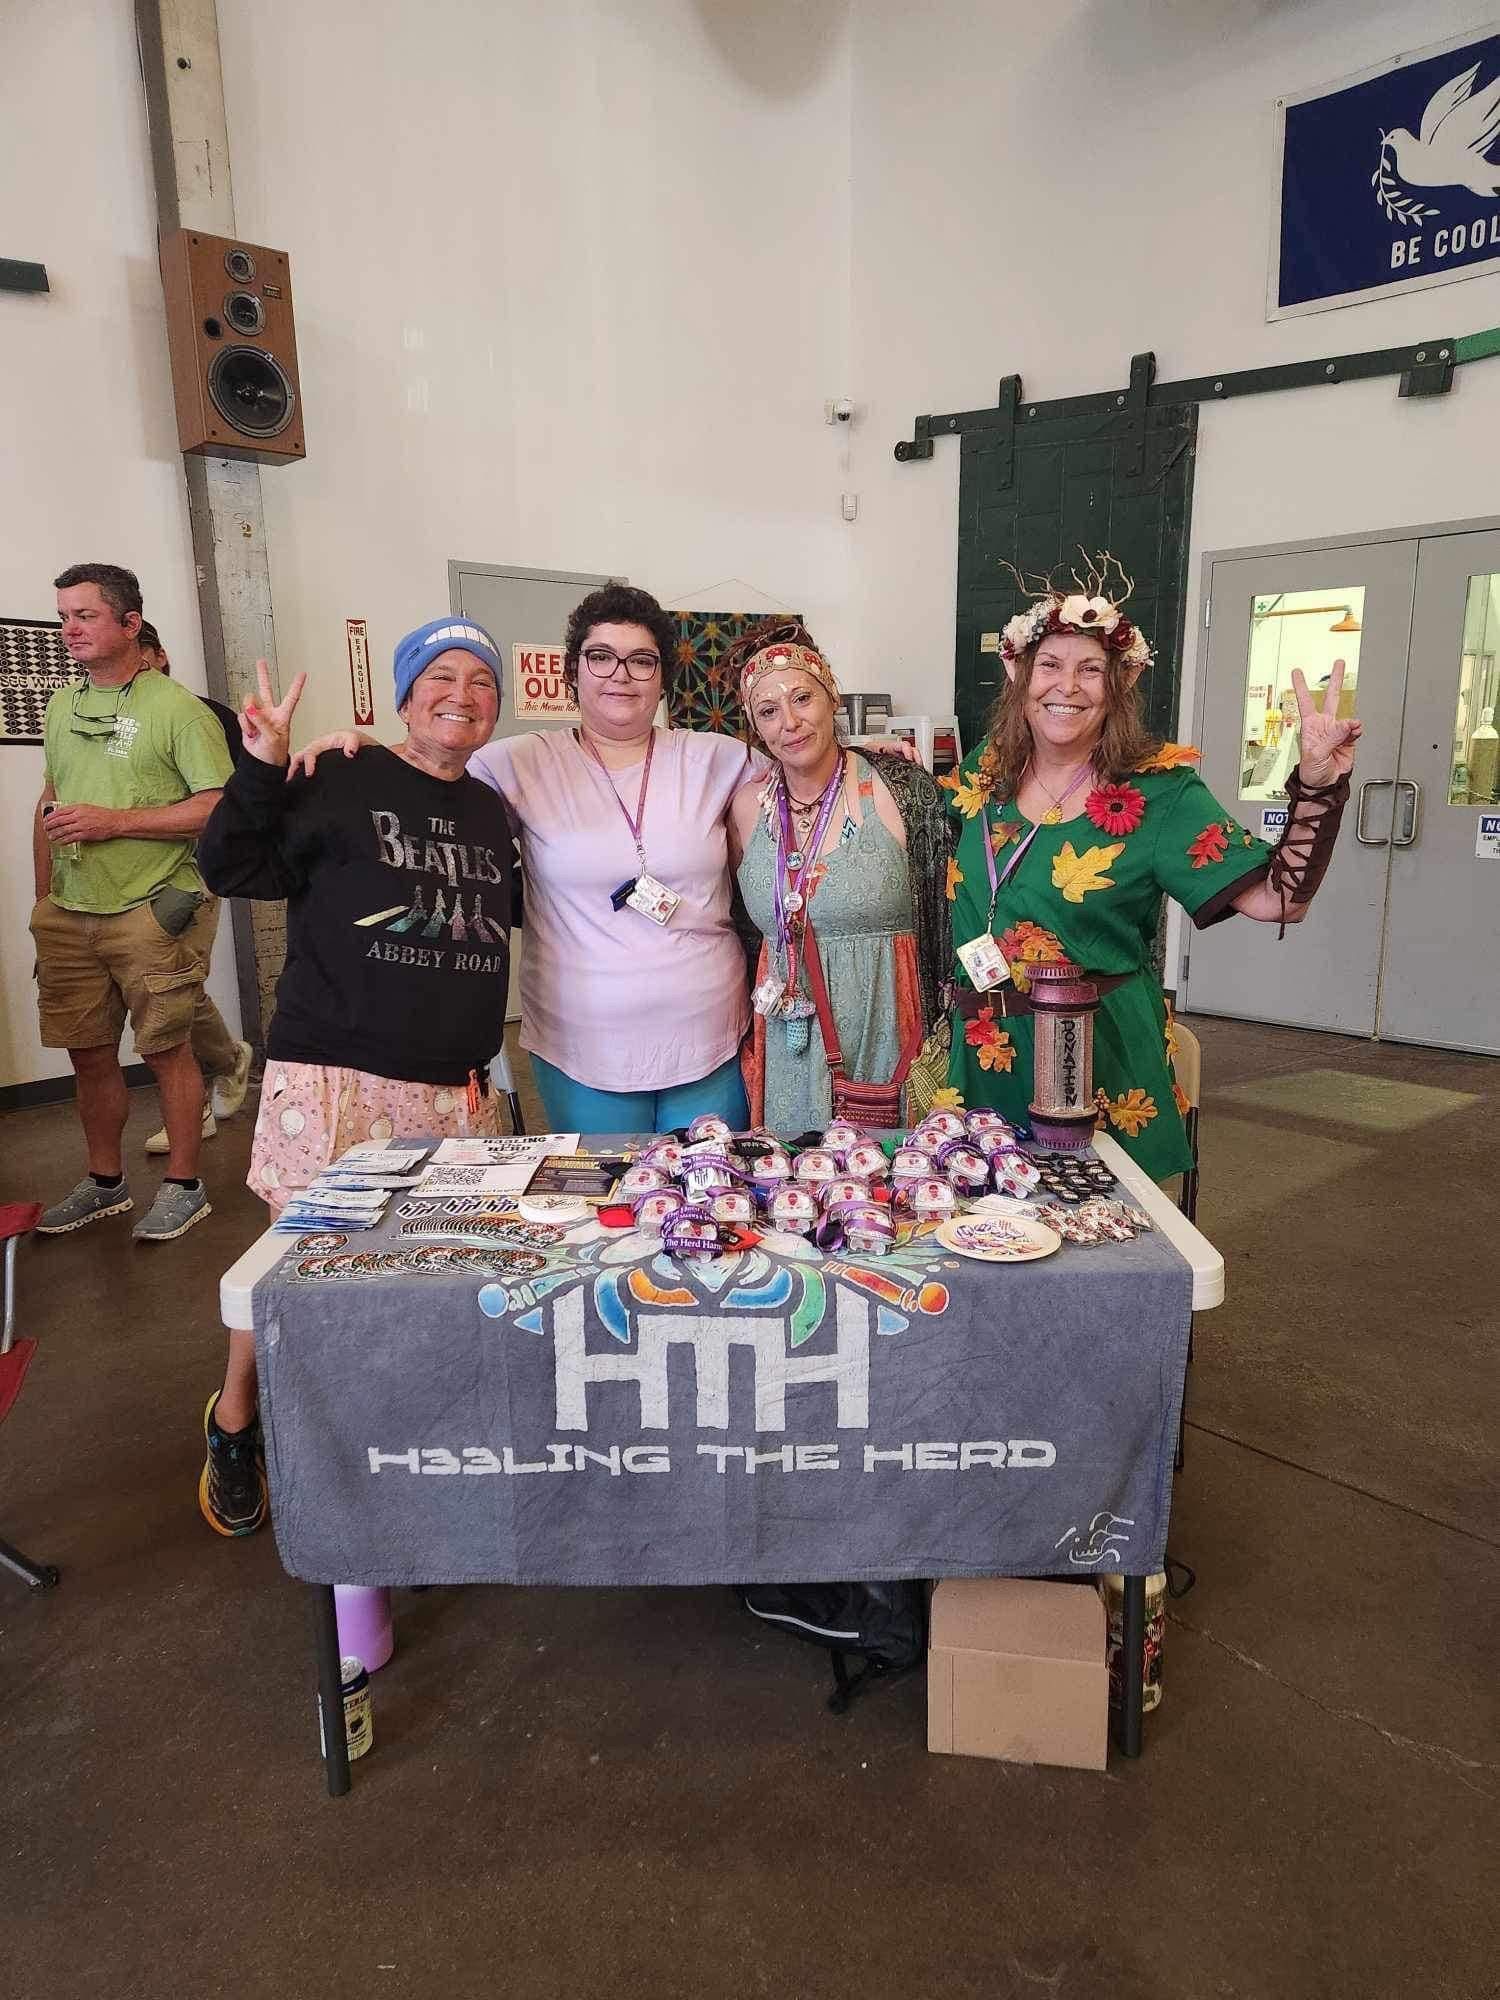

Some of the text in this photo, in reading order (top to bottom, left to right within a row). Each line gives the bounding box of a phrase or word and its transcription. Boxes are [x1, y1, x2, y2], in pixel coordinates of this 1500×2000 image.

[1390, 215, 1500, 269] BE COOL
[349, 626, 364, 636] FIRE
[520, 652, 562, 675] KEE
[0, 675, 29, 689] SEE
[355, 638, 366, 714] EXTINGUISHER
[525, 677, 569, 699] OUT
[540, 702, 564, 712] Means
[427, 817, 456, 836] THE
[1266, 813, 1289, 824] NOT
[369, 809, 501, 887] BEATLES
[366, 940, 501, 973] ABBEY ROAD
[665, 1238, 679, 1247] The
[680, 1238, 701, 1249] Herd
[553, 1284, 869, 1432] HTH
[696, 1443, 840, 1474] THE
[863, 1439, 1057, 1473] HERD
